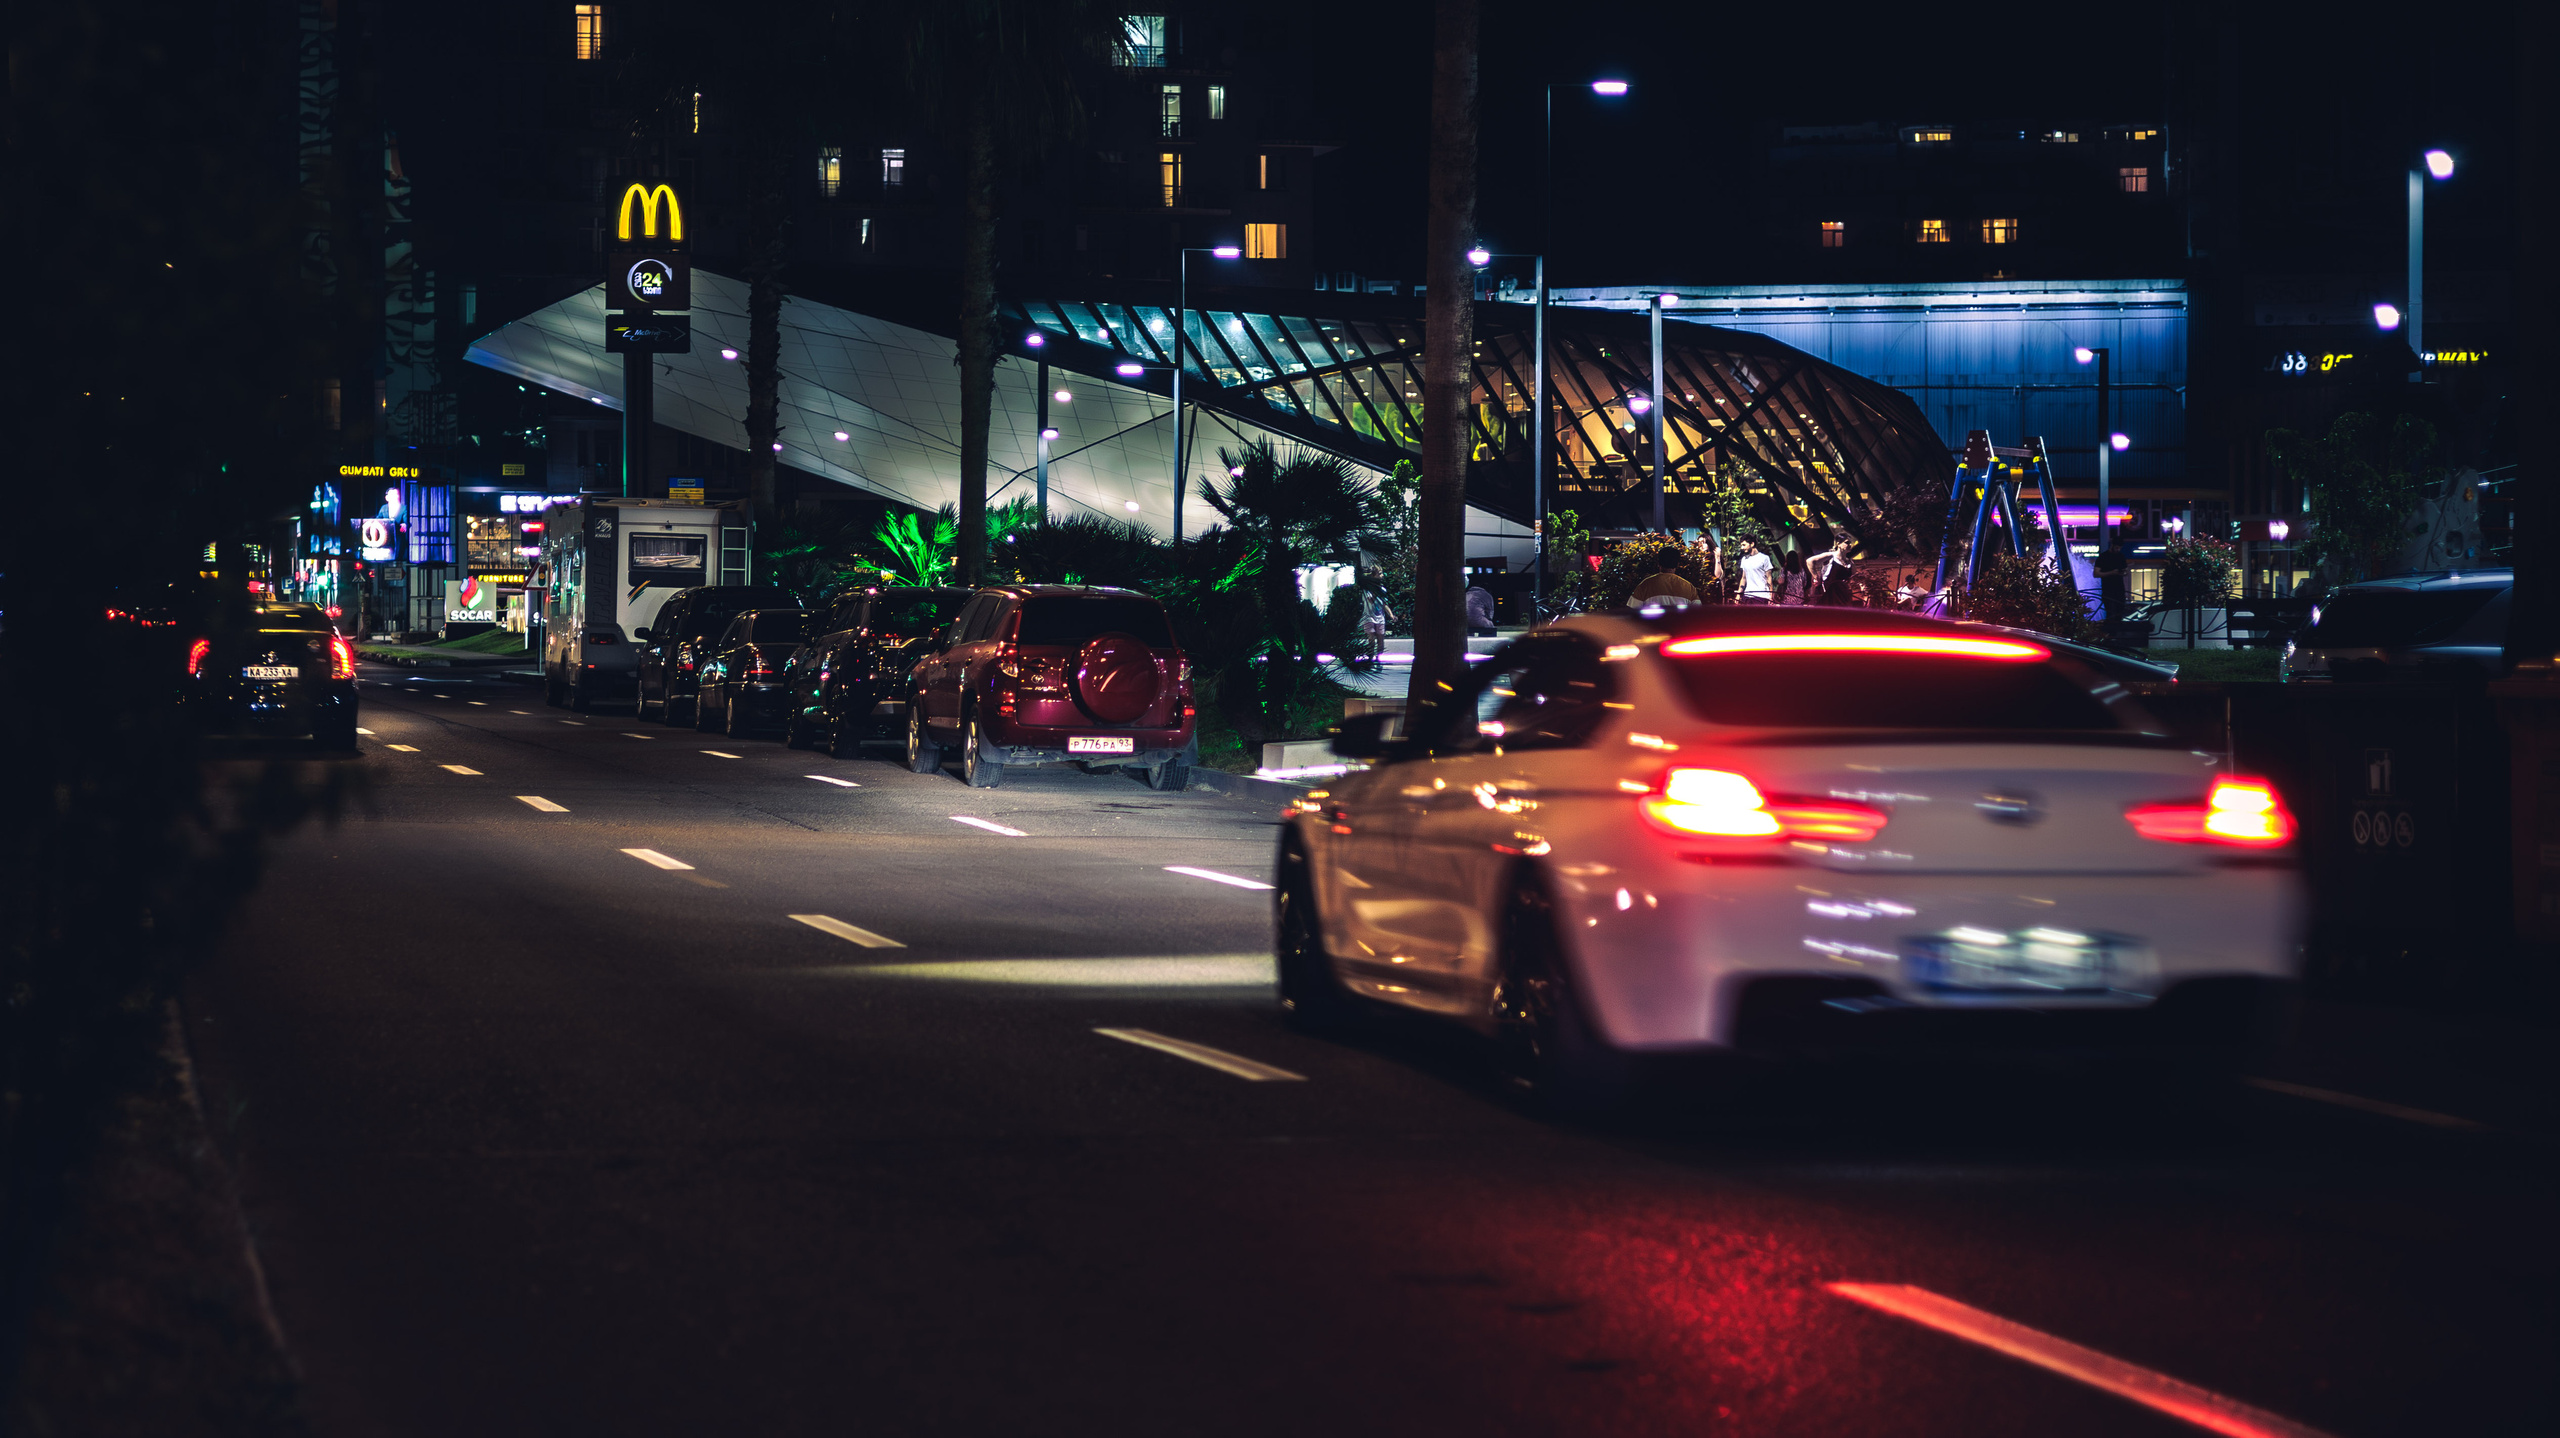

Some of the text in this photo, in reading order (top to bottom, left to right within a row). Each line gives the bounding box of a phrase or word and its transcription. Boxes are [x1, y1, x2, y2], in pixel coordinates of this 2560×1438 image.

[642, 272, 663, 287] 24
[339, 465, 384, 477] GUMBATI
[478, 574, 524, 583] FURNITURE
[450, 610, 493, 621] SOCAR
